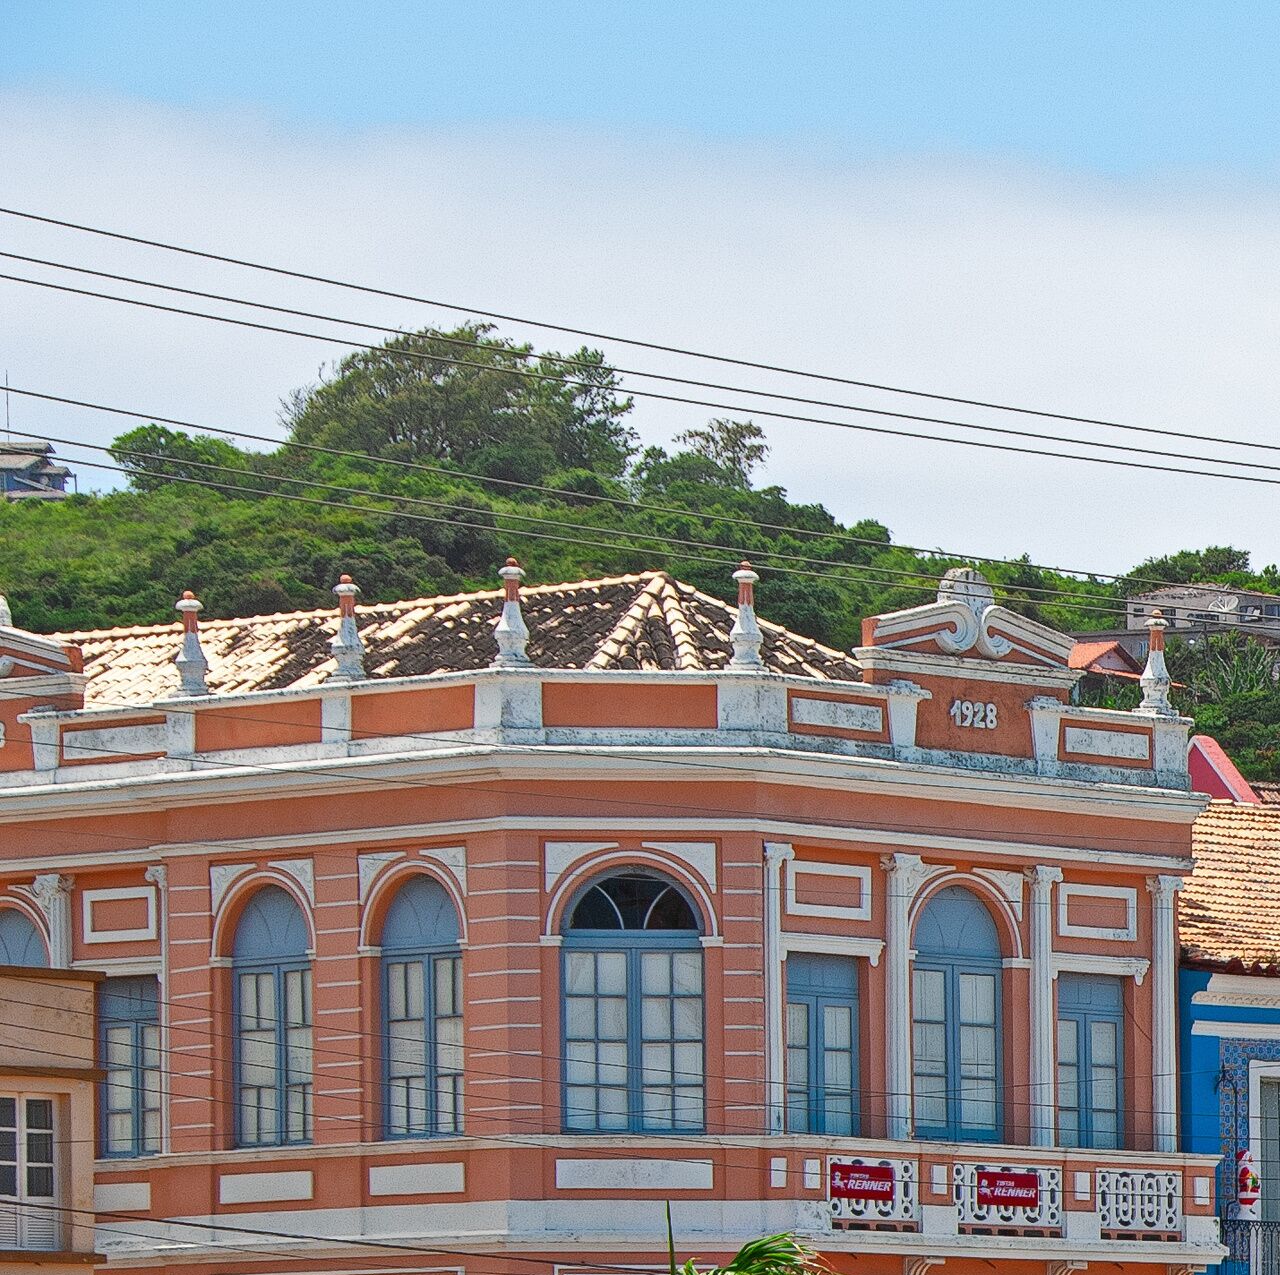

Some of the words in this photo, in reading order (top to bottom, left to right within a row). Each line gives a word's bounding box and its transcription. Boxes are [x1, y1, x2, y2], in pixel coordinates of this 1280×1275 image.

[950, 699, 998, 730] 1928
[847, 1180, 892, 1191] RENNER
[994, 1187, 1036, 1198] RENNER
